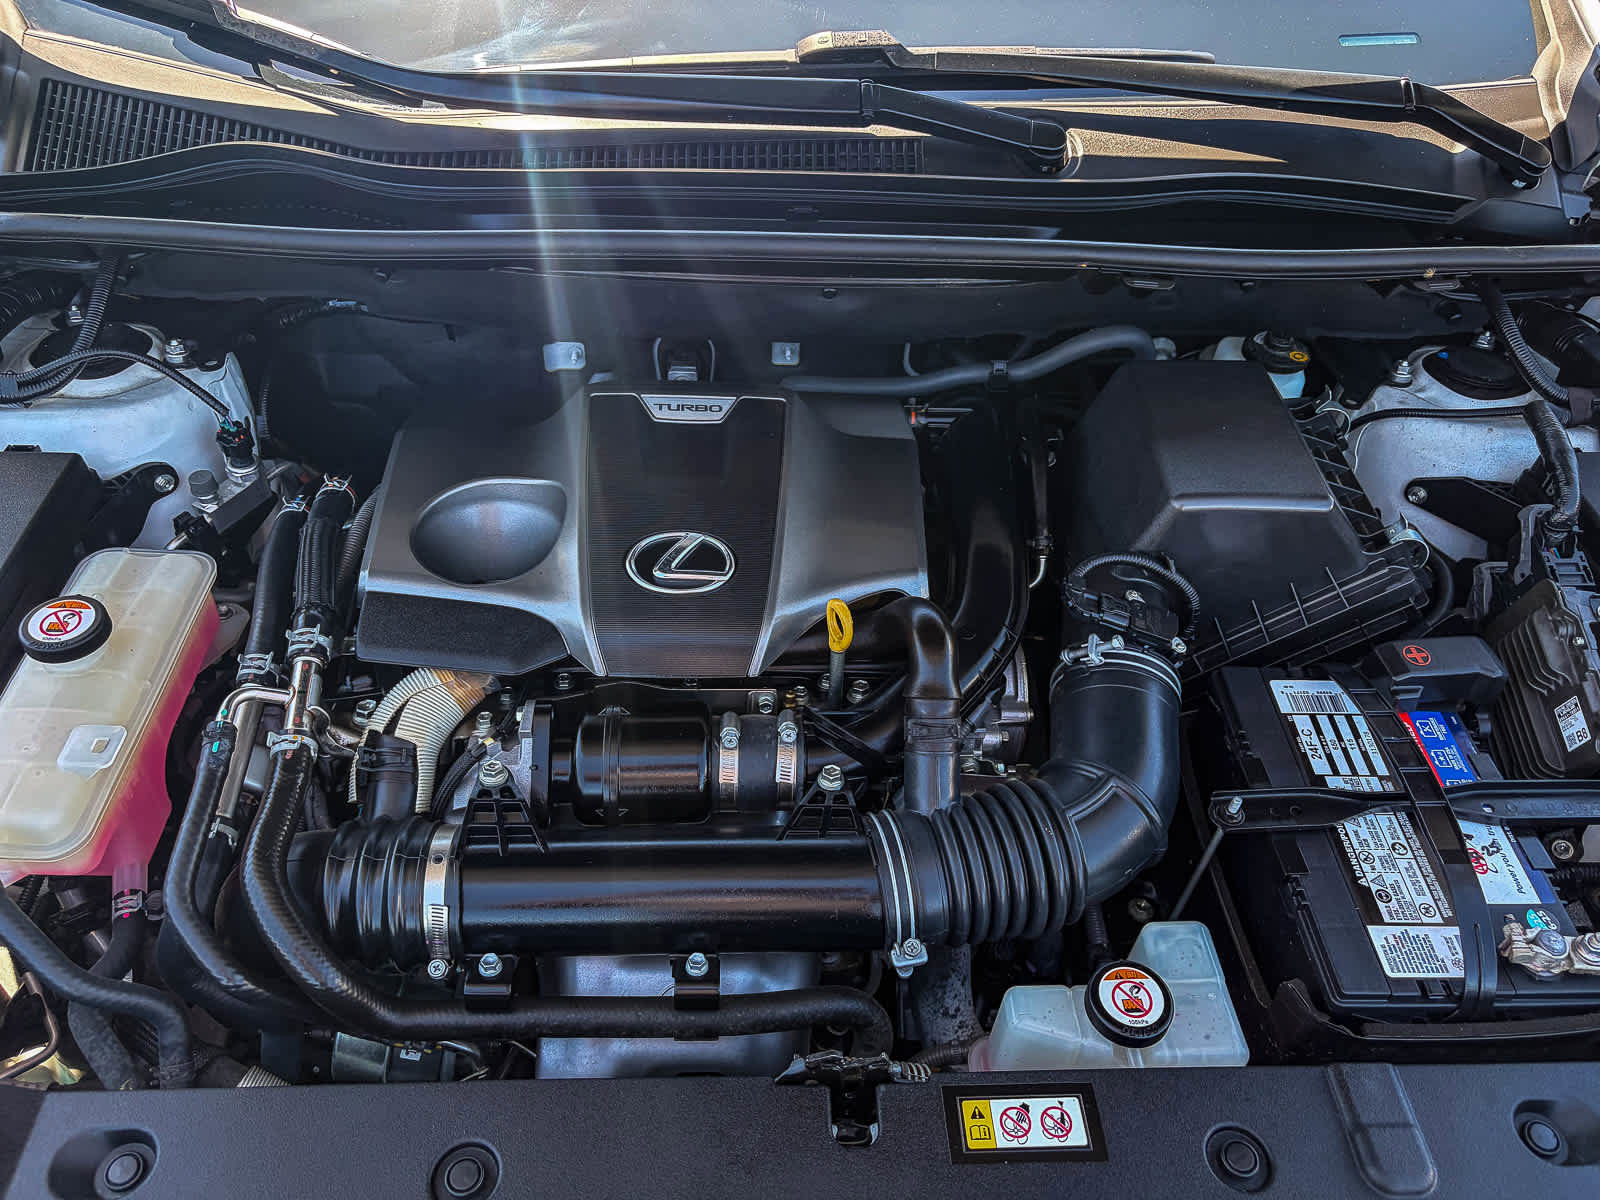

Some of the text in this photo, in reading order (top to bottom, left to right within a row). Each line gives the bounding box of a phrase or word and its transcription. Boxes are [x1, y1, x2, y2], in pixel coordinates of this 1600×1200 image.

[654, 403, 723, 412] TURBO
[1301, 728, 1322, 759] 24F-C
[1336, 824, 1363, 876] DANGER/POI
[1500, 852, 1514, 868] you
[1507, 867, 1526, 894] Power
